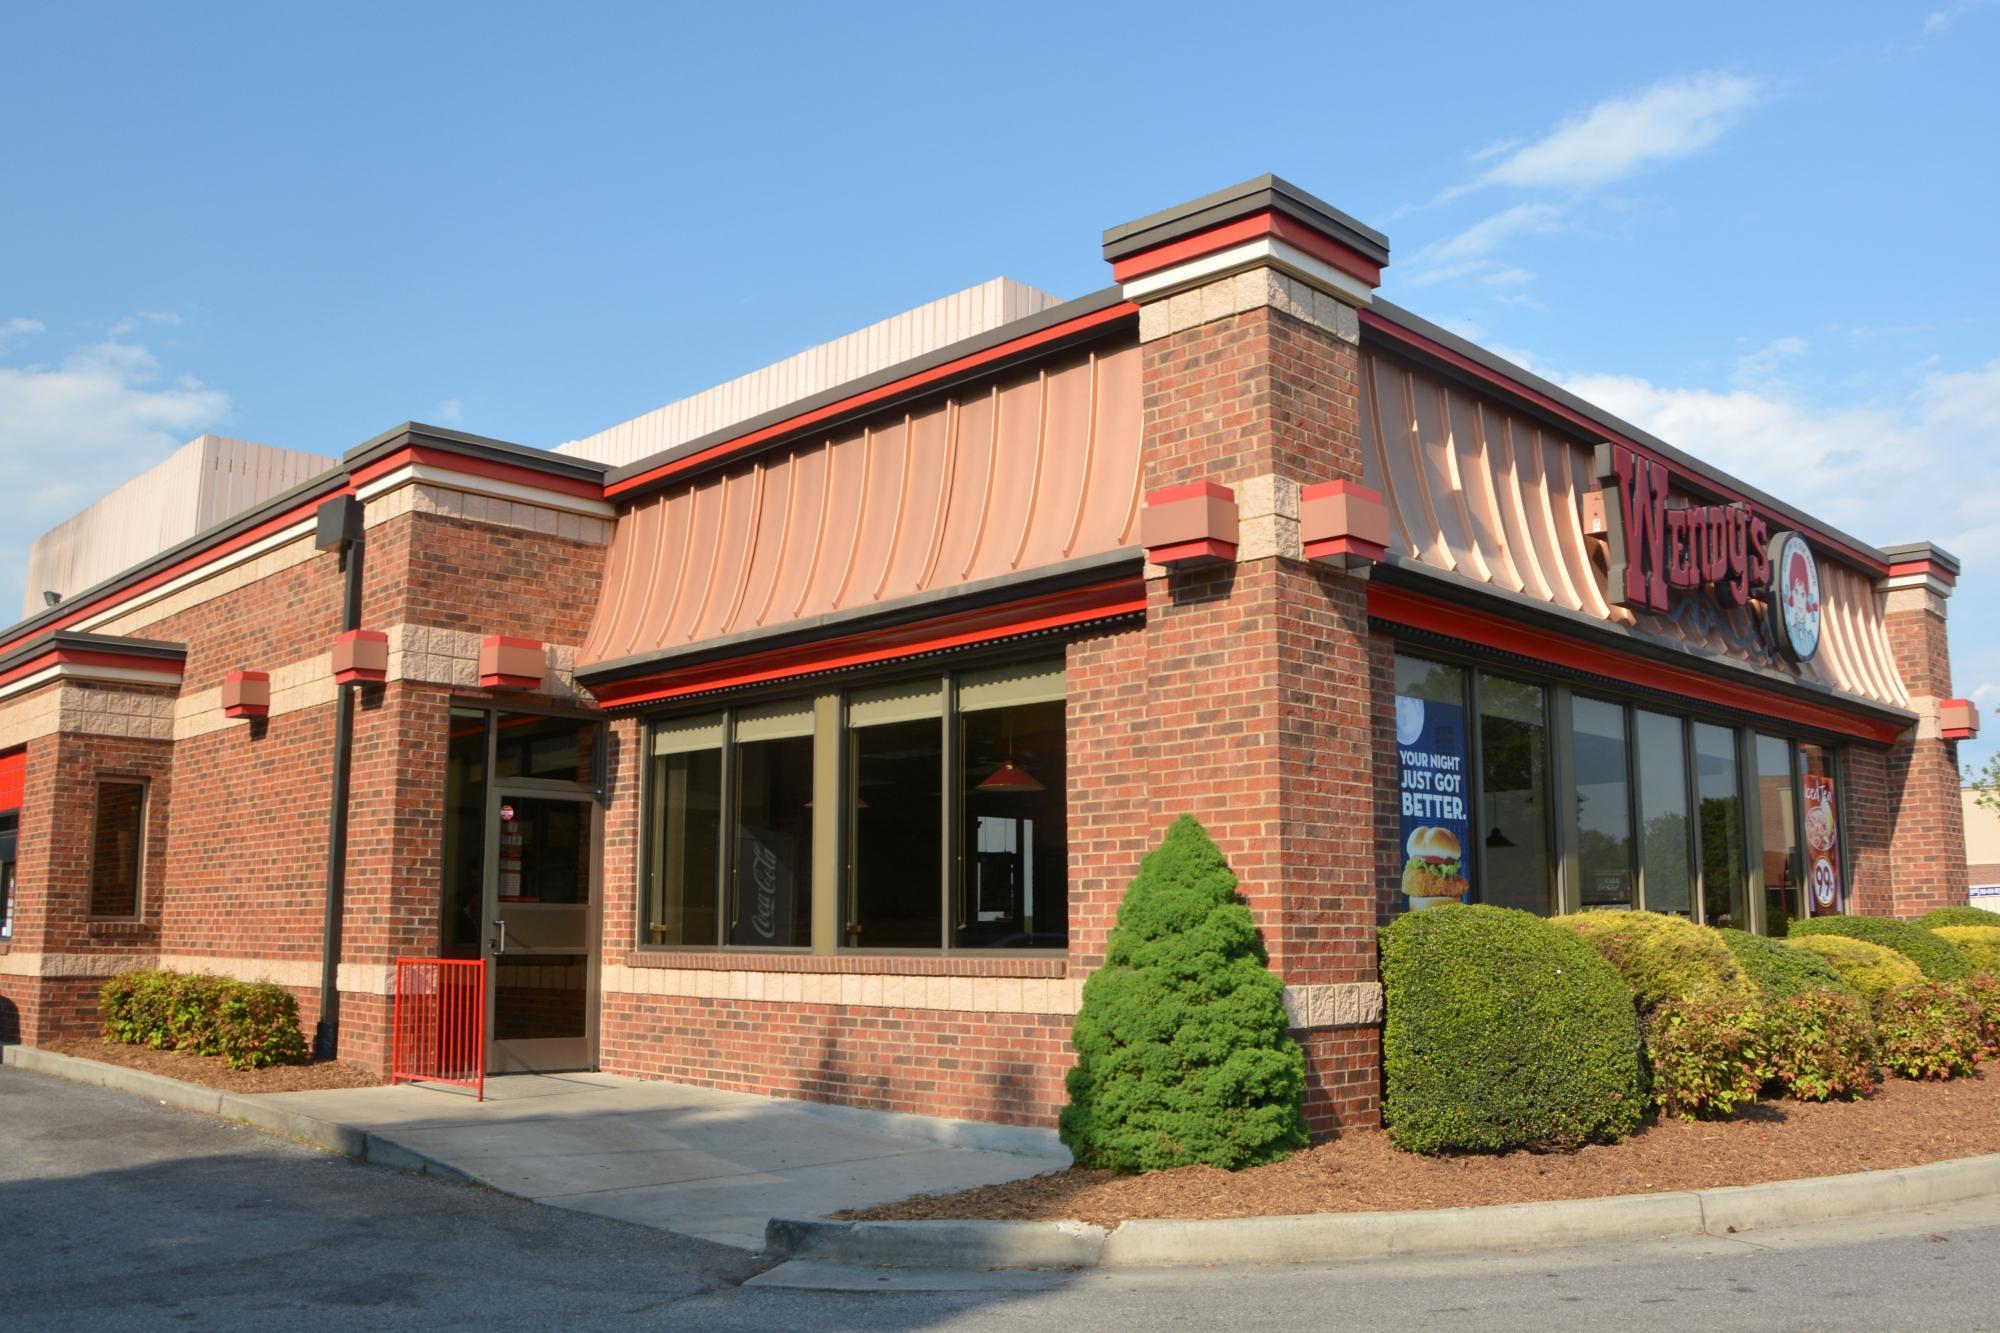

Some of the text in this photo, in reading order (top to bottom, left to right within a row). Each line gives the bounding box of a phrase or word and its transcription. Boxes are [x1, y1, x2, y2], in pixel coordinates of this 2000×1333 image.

[1400, 750, 1460, 771] YOUR NIGHT
[1401, 769, 1461, 793] JUST GOT
[1402, 792, 1467, 820] BETTER.
